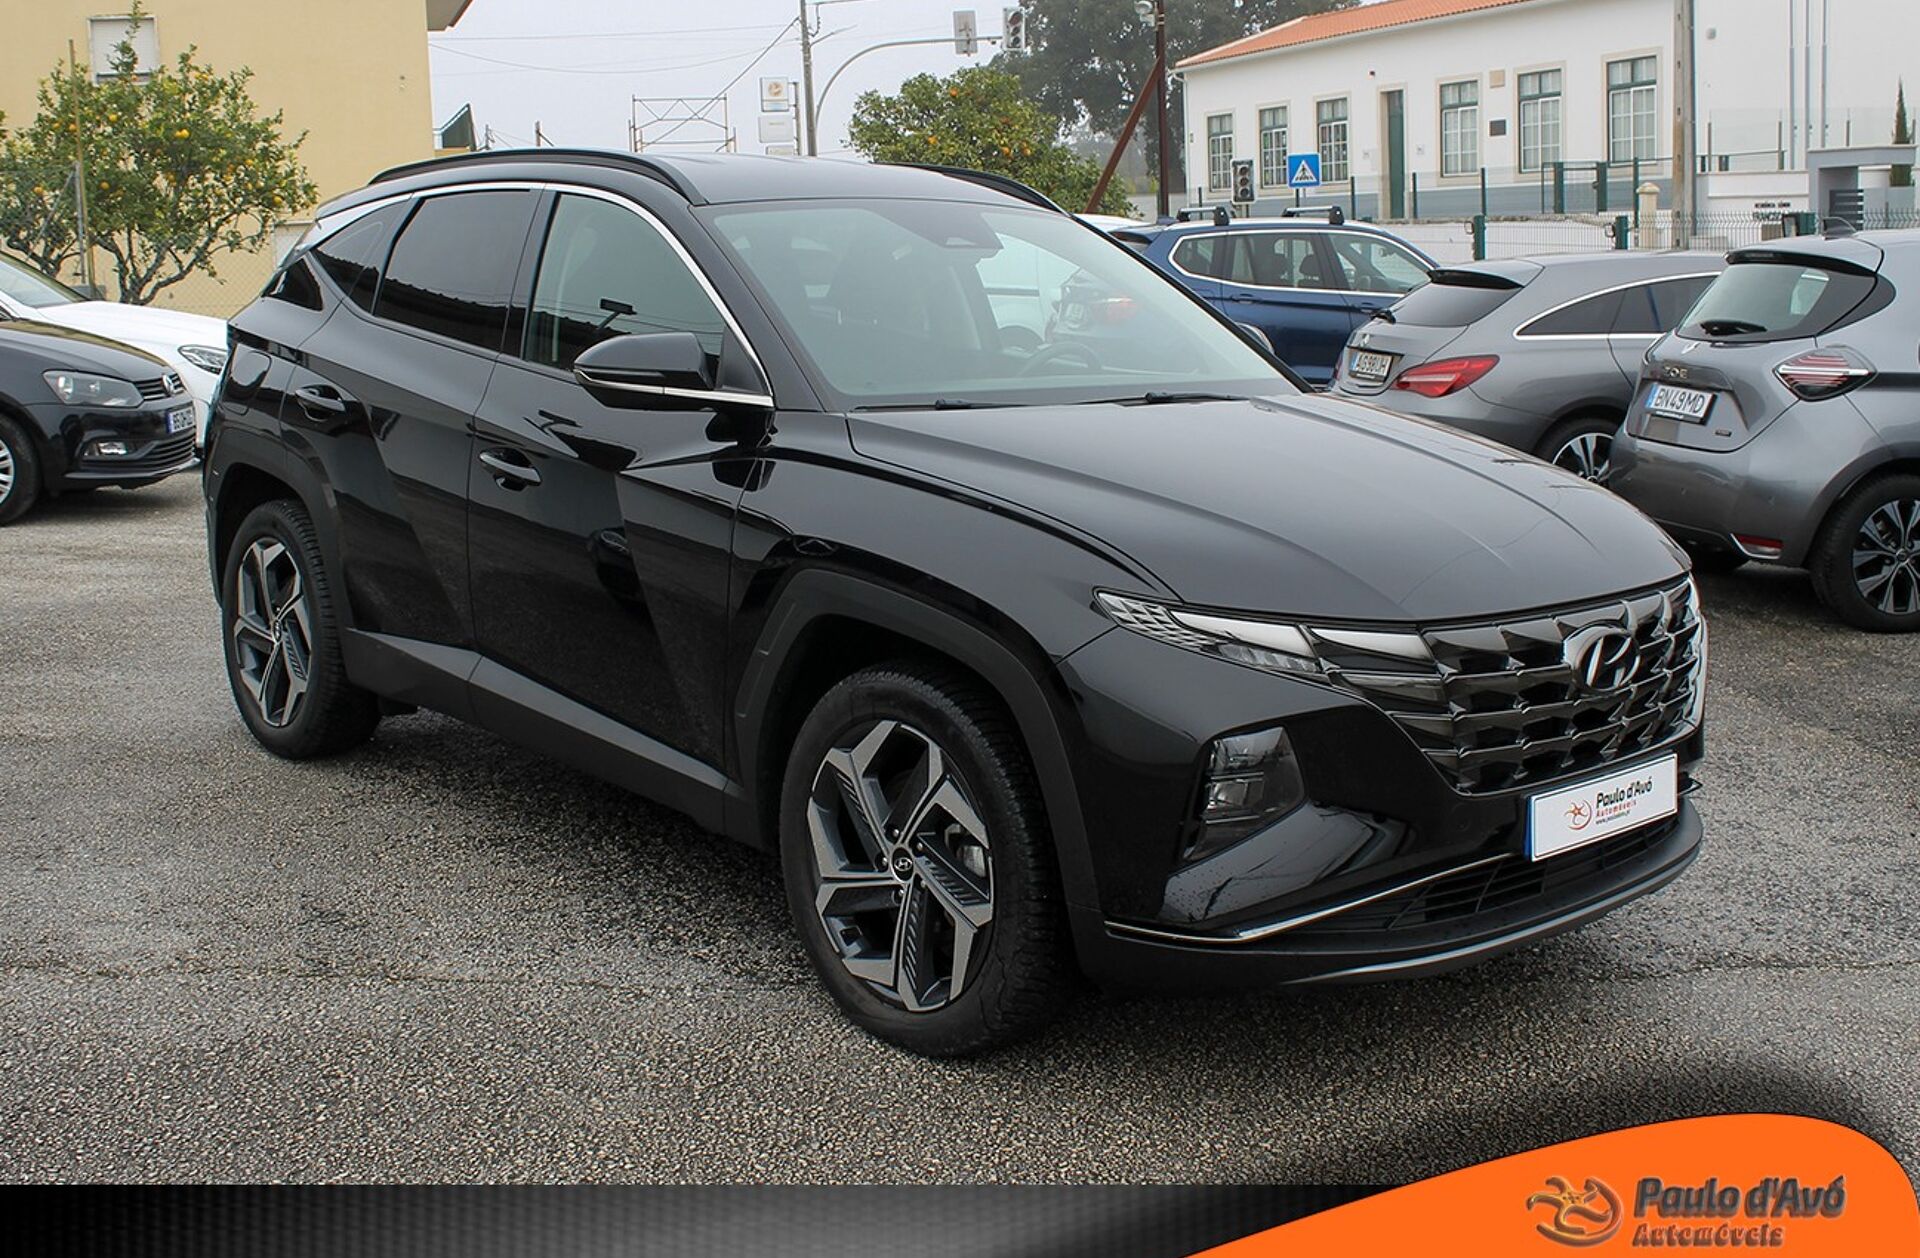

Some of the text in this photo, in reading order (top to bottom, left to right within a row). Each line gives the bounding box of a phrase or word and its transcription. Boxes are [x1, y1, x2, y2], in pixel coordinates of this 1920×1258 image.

[1654, 387, 1705, 414] BN49MD
[1596, 776, 1653, 809] Paulo d'Avó
